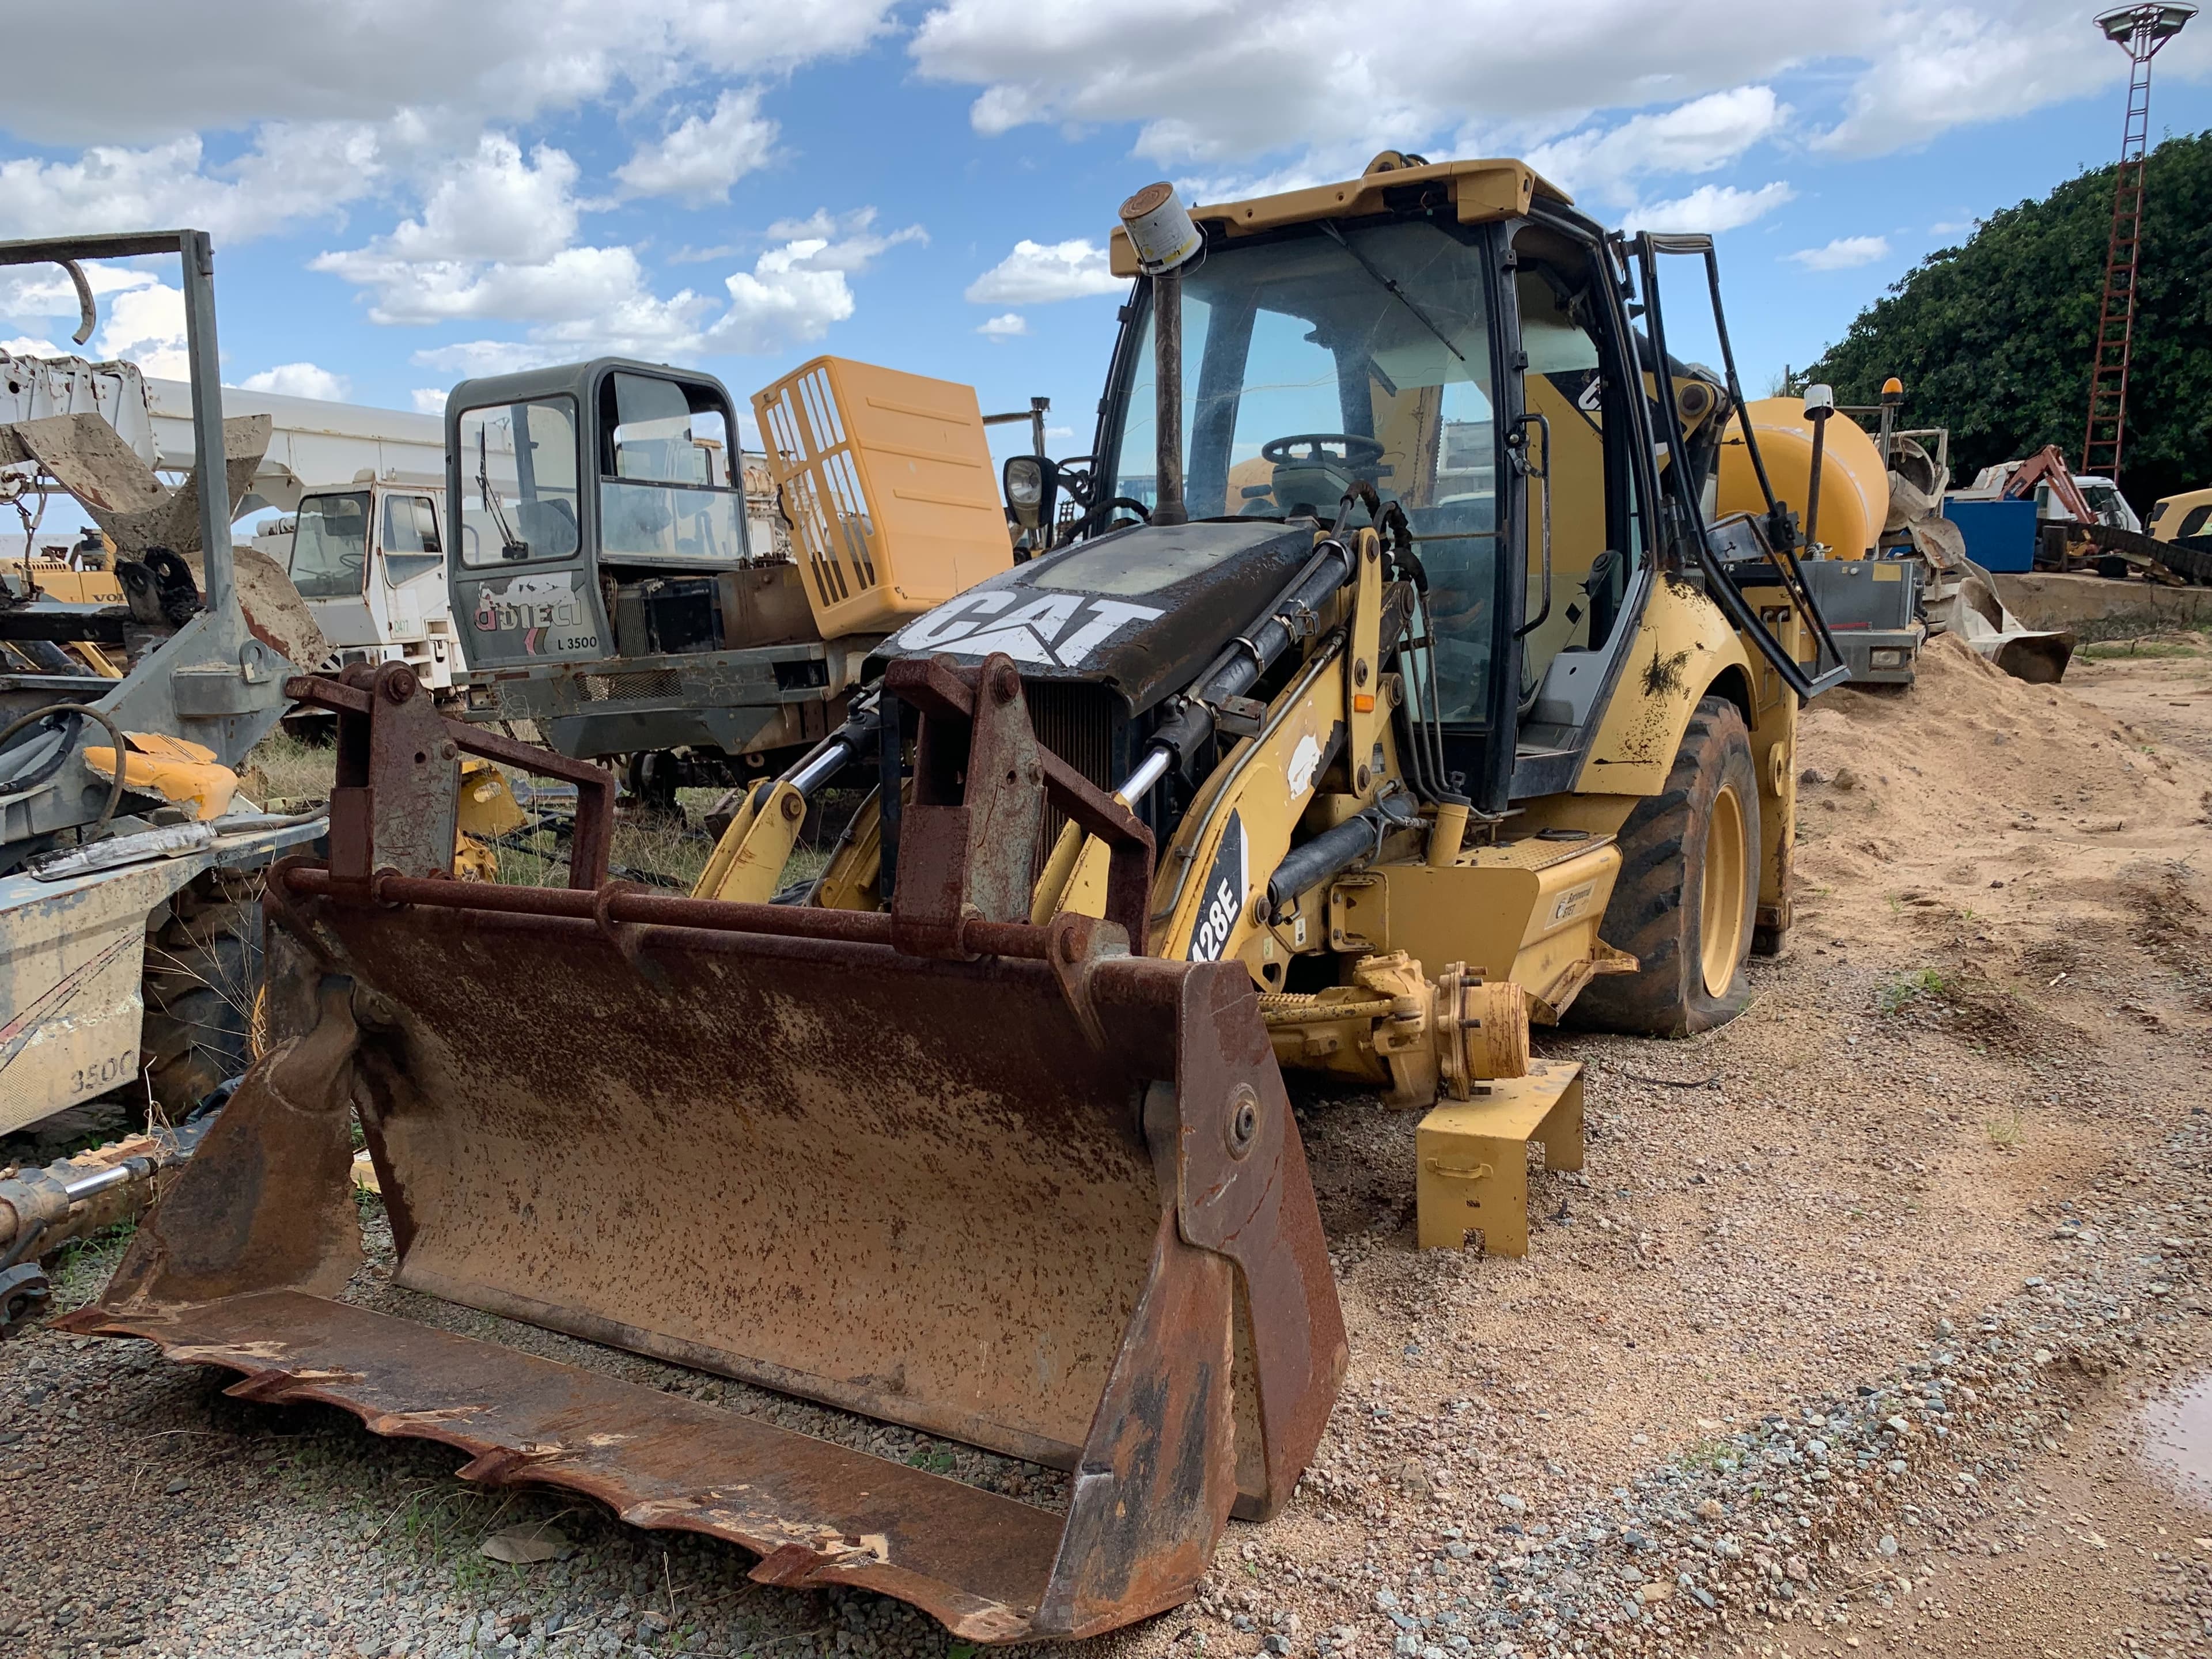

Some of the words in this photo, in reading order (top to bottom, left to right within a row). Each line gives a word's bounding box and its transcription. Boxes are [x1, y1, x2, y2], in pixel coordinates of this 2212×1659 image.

[558, 639, 563, 650] L
[567, 637, 597, 649] 3500
[897, 590, 1166, 668] CAT
